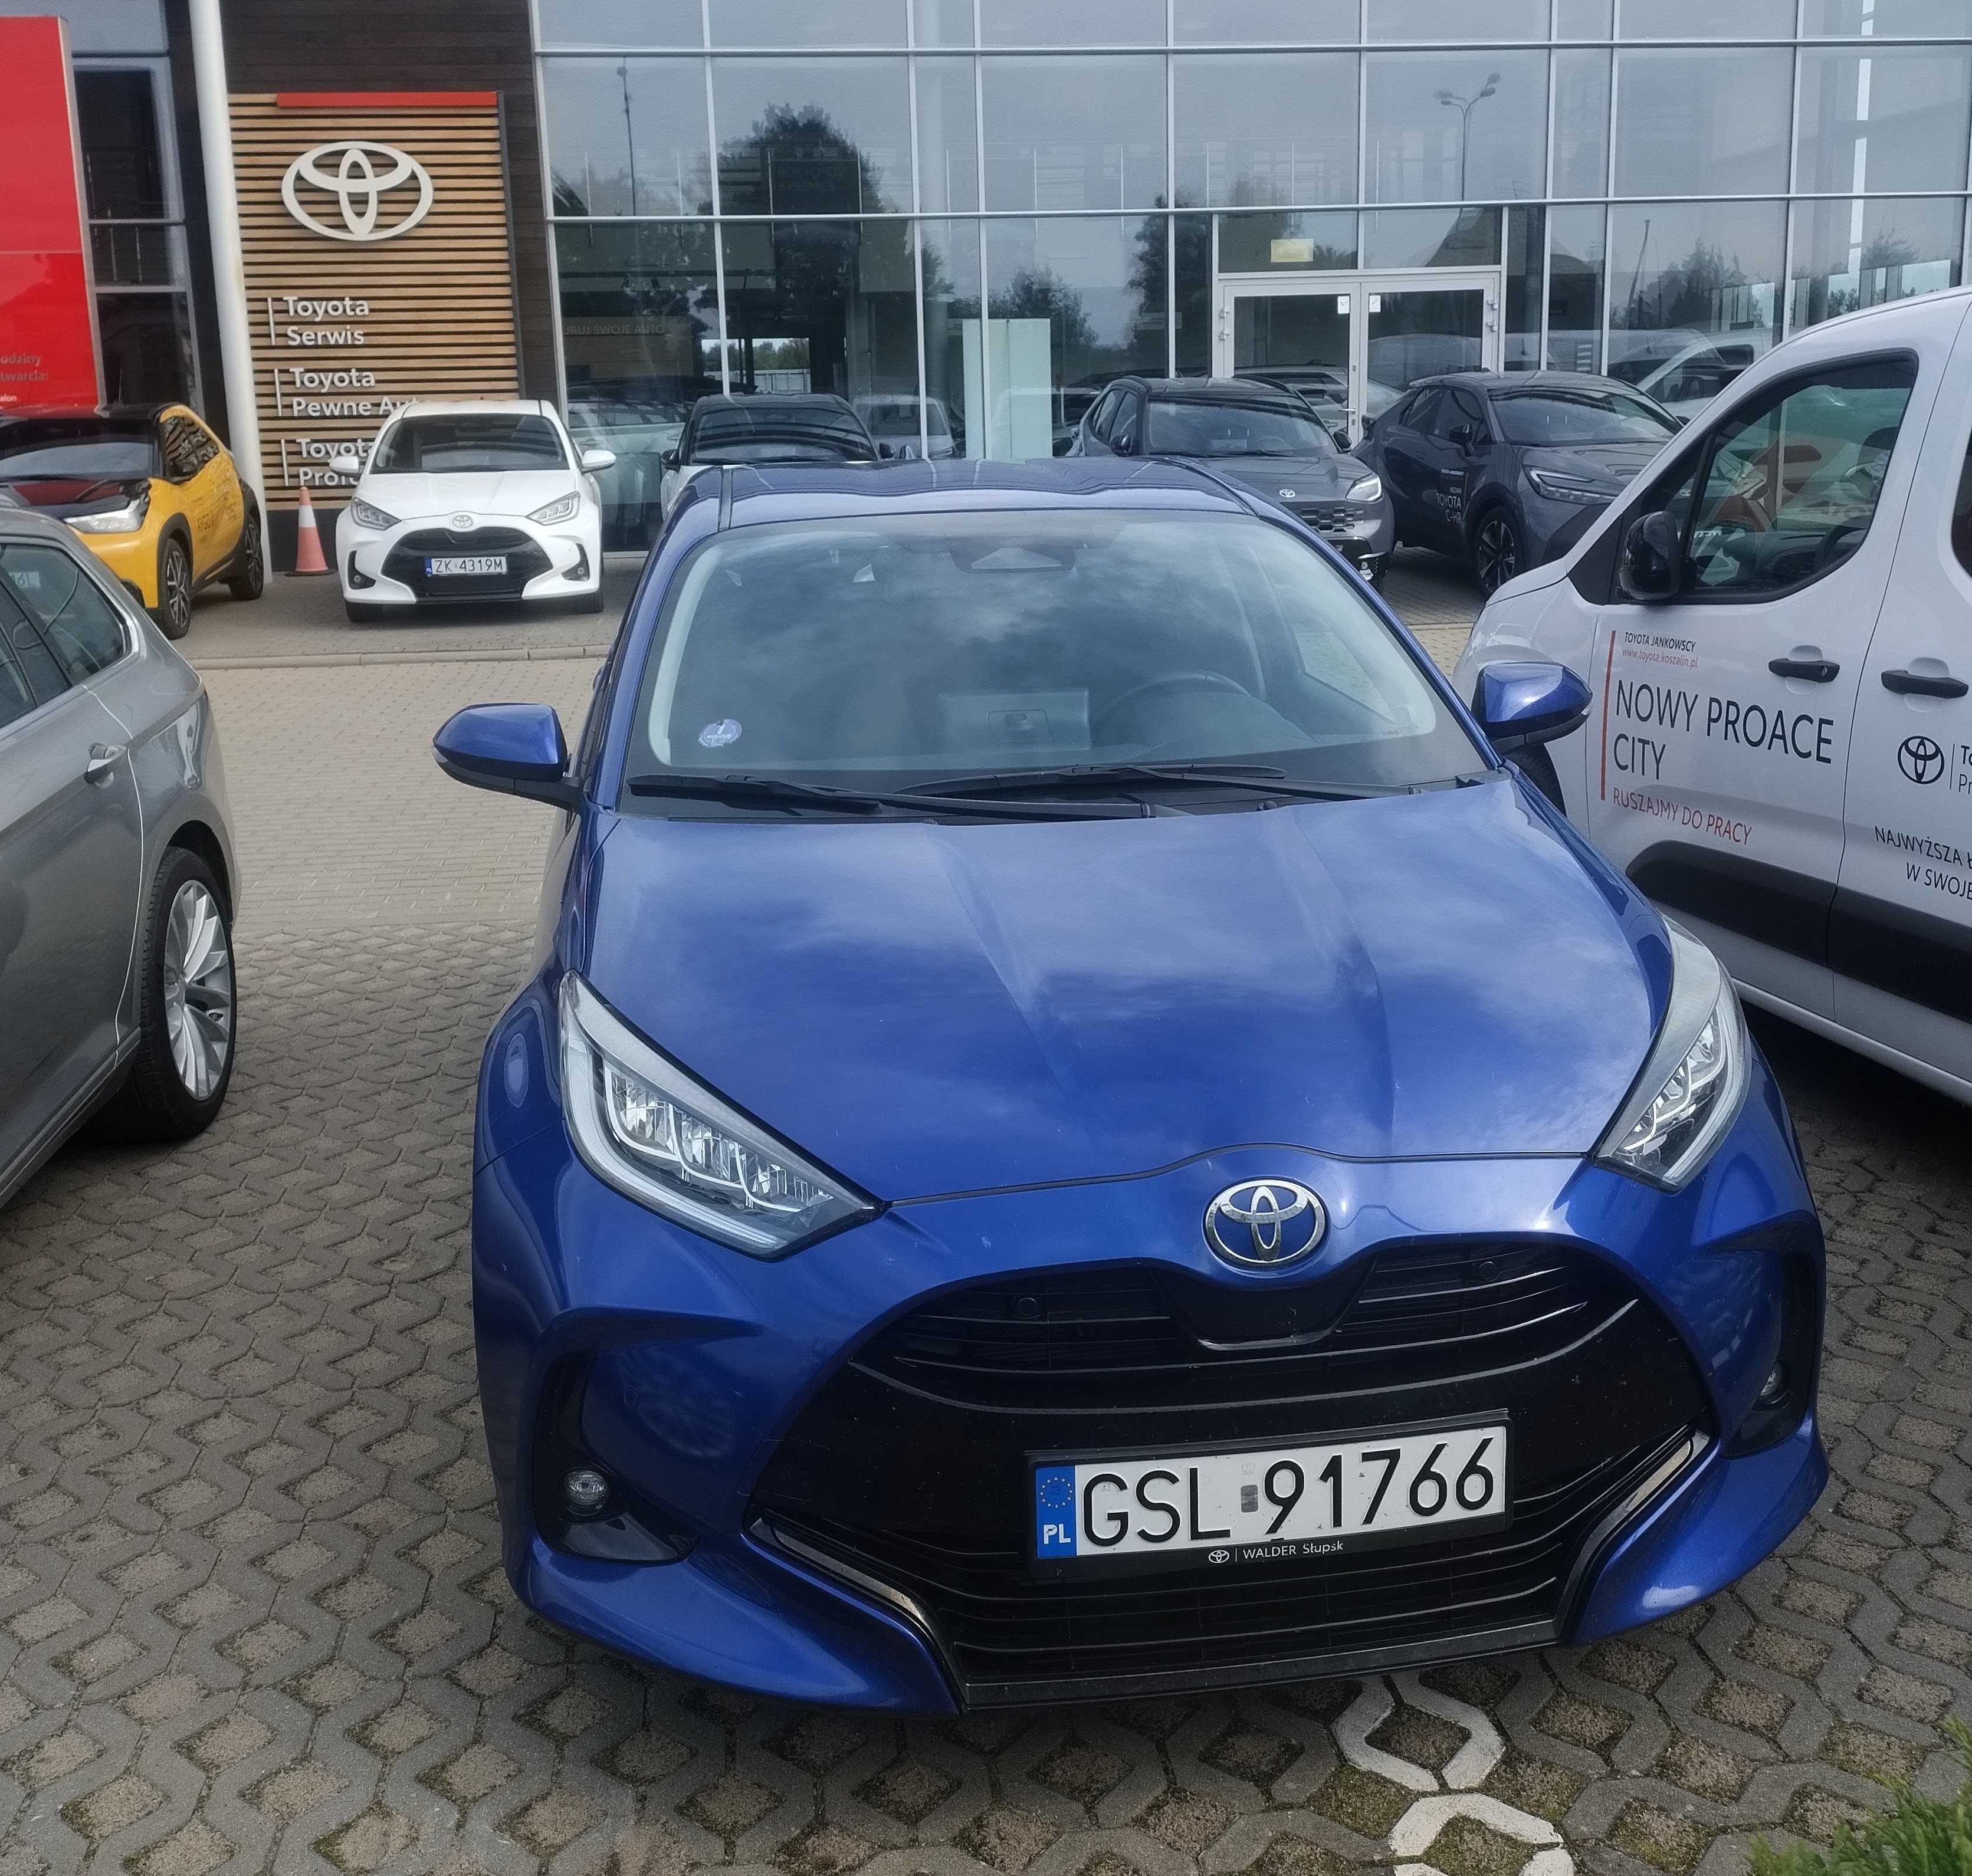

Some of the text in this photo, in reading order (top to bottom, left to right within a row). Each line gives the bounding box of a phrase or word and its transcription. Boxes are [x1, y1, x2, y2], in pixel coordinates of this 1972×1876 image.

[283, 296, 369, 322] Toyota
[287, 325, 365, 346] Serwis
[290, 367, 375, 393] Toyota
[293, 397, 372, 416] Pewne
[1436, 492, 1462, 510] TOYOTA
[1445, 510, 1462, 524] C-HR
[435, 560, 452, 573] ZK
[459, 558, 503, 572] 4319M
[1624, 632, 1697, 652] TOYOTA JANKOWSCY
[1622, 649, 1699, 671] www.toyota.koszalin.pl
[1616, 679, 1834, 764] NOWY PROACE
[1613, 733, 1666, 780] CITY
[1613, 787, 1753, 845] RUSZAJMY DO PRACY
[1875, 825, 1963, 867] NAJWYŻSZA
[1906, 862, 1921, 883] W
[1083, 1437, 1494, 1547] GSL 91766
[1044, 1523, 1071, 1545] PL
[1243, 1540, 1343, 1559] WALDER Słupsk
